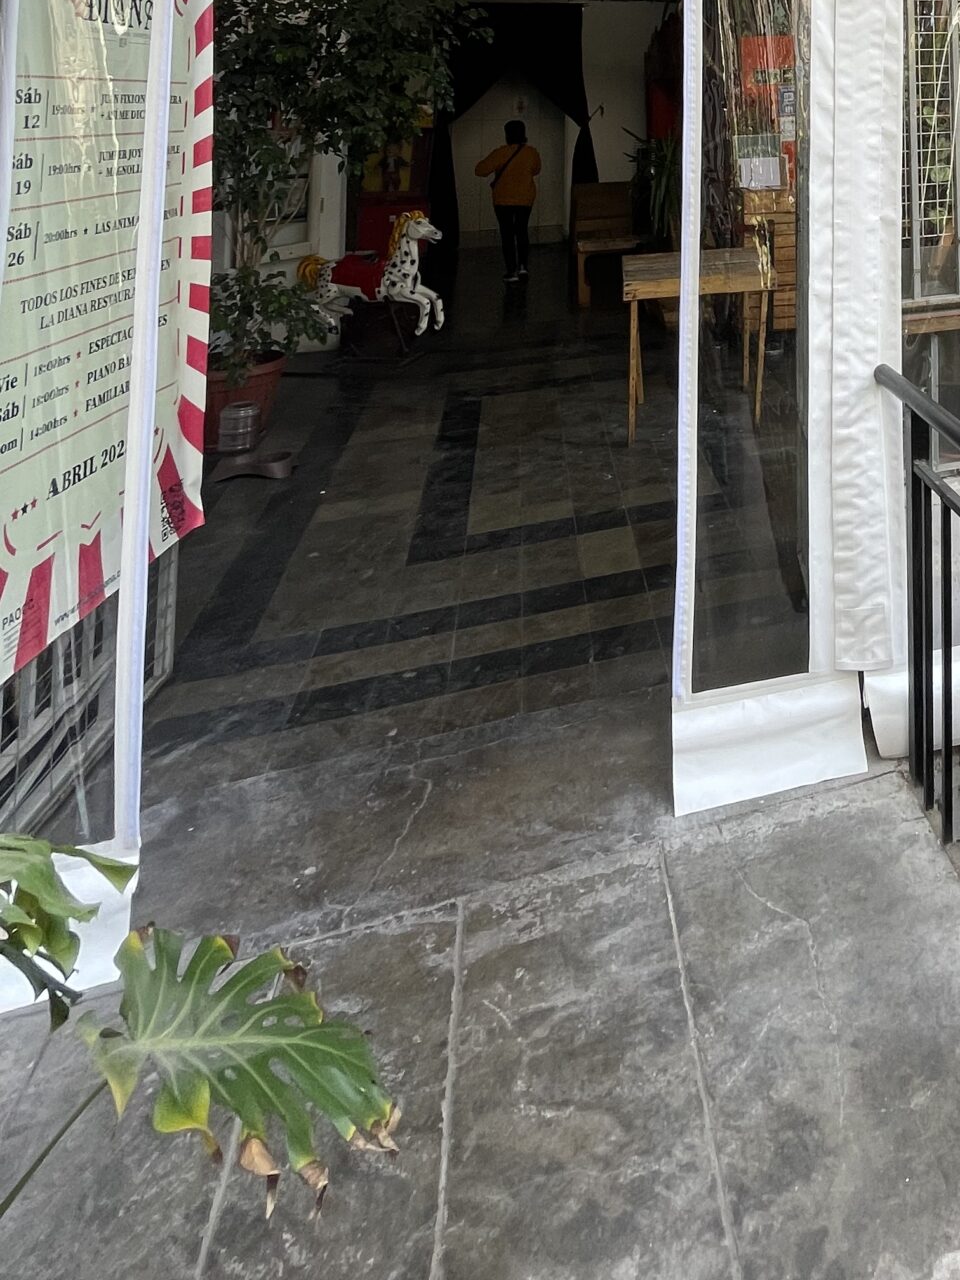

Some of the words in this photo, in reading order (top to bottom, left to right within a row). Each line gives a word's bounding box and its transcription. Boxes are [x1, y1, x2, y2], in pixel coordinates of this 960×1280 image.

[15, 86, 42, 105] Sáb
[23, 114, 41, 130] 12
[98, 148, 127, 164] JUMER
[105, 163, 144, 177] MGNOLI
[15, 179, 32, 196] 19
[6, 222, 32, 242] Sáb
[95, 220, 111, 235] LAS
[8, 250, 25, 268] 26
[20, 290, 58, 314] TODOS
[59, 284, 78, 302] LOS
[80, 275, 107, 296] FINES
[108, 271, 121, 288] DE
[39, 312, 55, 330] LA
[57, 302, 88, 324] DIANA
[90, 286, 136, 313] RESTAURA
[88, 325, 134, 355] ESPECTAC
[31, 384, 70, 409] 18:00hrs
[87, 361, 117, 385] PIANO
[117, 354, 132, 371] BA
[0, 401, 20, 423] áb
[30, 415, 68, 441] 14:00hrs
[46, 455, 98, 500] ABRIL
[100, 439, 127, 469] 202
